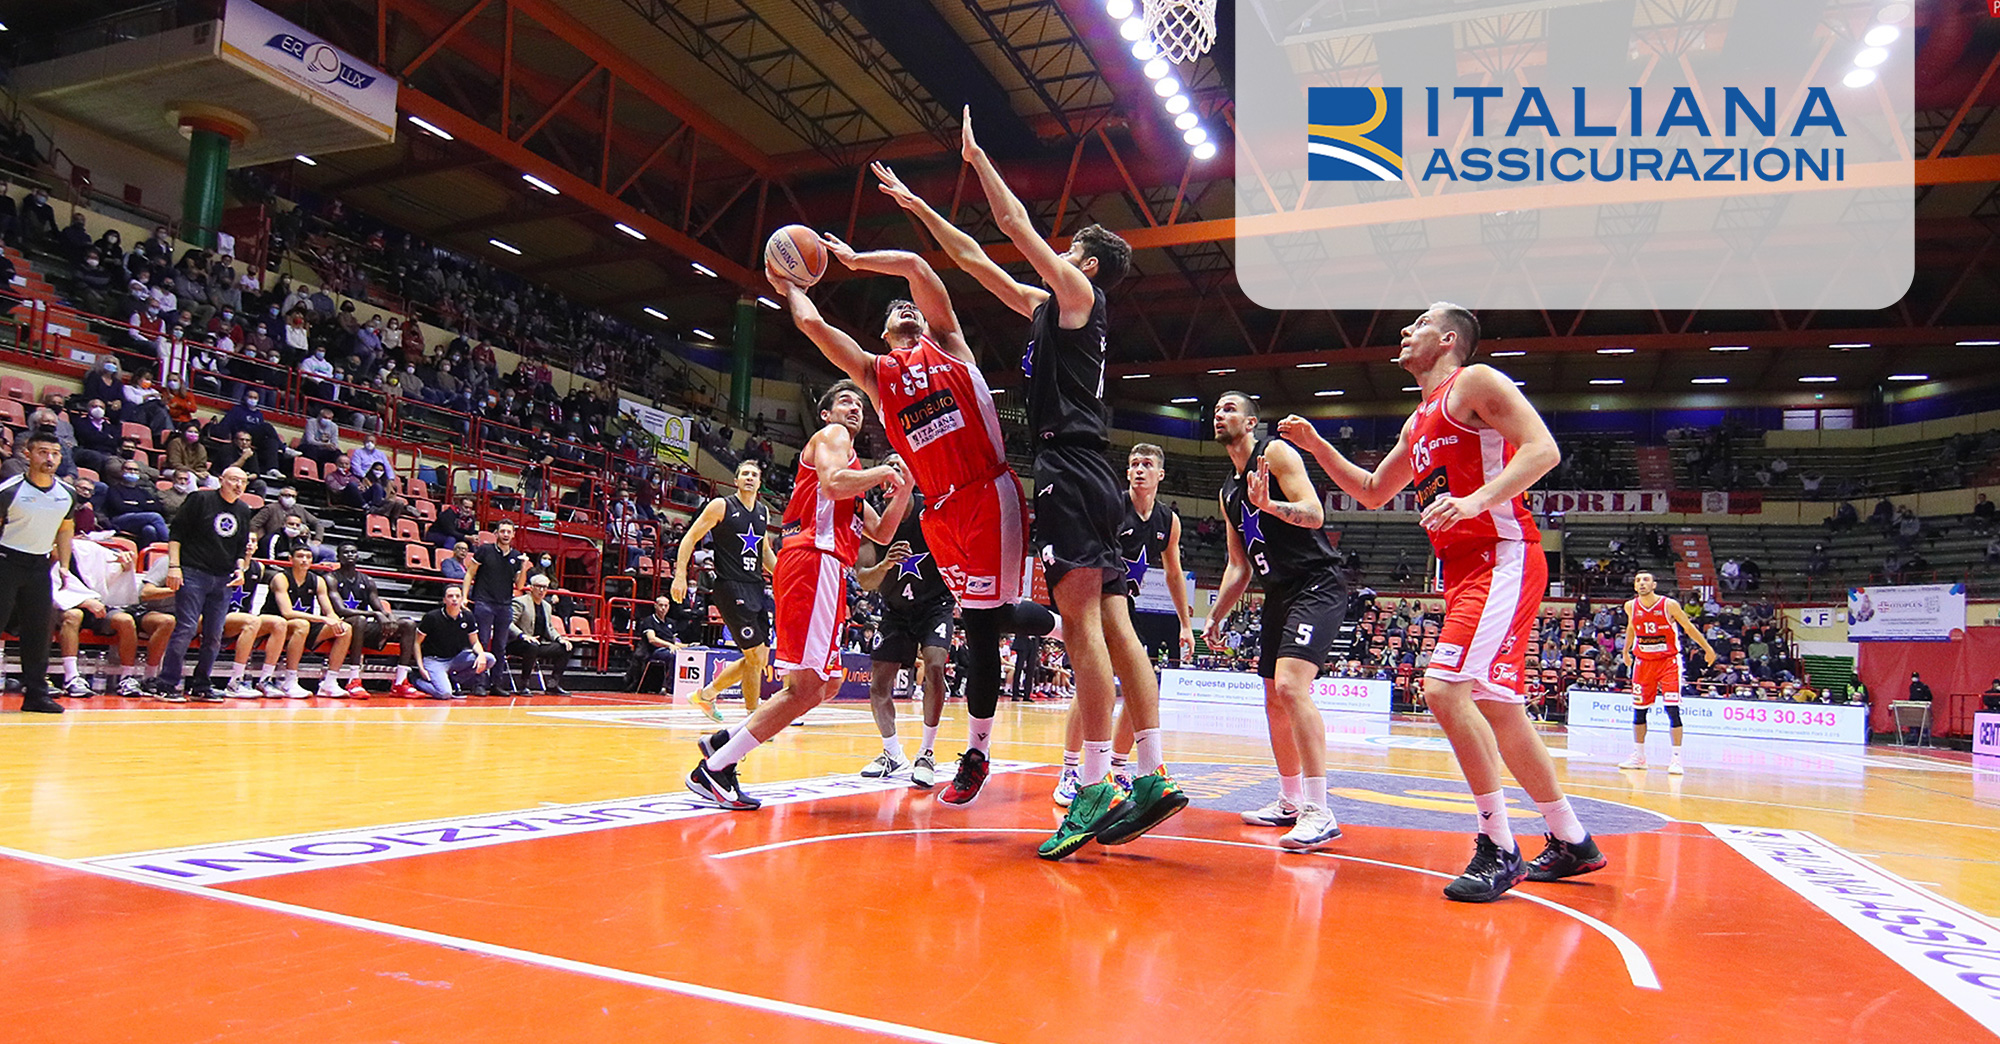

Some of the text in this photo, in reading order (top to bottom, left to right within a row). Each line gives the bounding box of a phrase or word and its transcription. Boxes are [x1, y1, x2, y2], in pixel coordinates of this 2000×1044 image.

[340, 66, 366, 90] LUX
[1412, 435, 1431, 473] 25
[743, 557, 757, 572] 55
[1254, 552, 1270, 575] 5
[902, 583, 914, 601] 4
[1209, 594, 1218, 605] F
[1643, 622, 1657, 634] 13
[1819, 613, 1829, 626] F
[934, 622, 948, 639] 4
[1294, 623, 1314, 646] 5
[848, 667, 874, 683] unieu
[1178, 677, 1193, 687] Per
[1195, 678, 1226, 690] questa
[1227, 679, 1265, 691] pubblici
[1319, 683, 1369, 698] 30.343
[1592, 701, 1611, 711] Per
[1614, 704, 1652, 713] quea
[1723, 706, 1767, 722] 0543
[1773, 709, 1836, 727] 30.343
